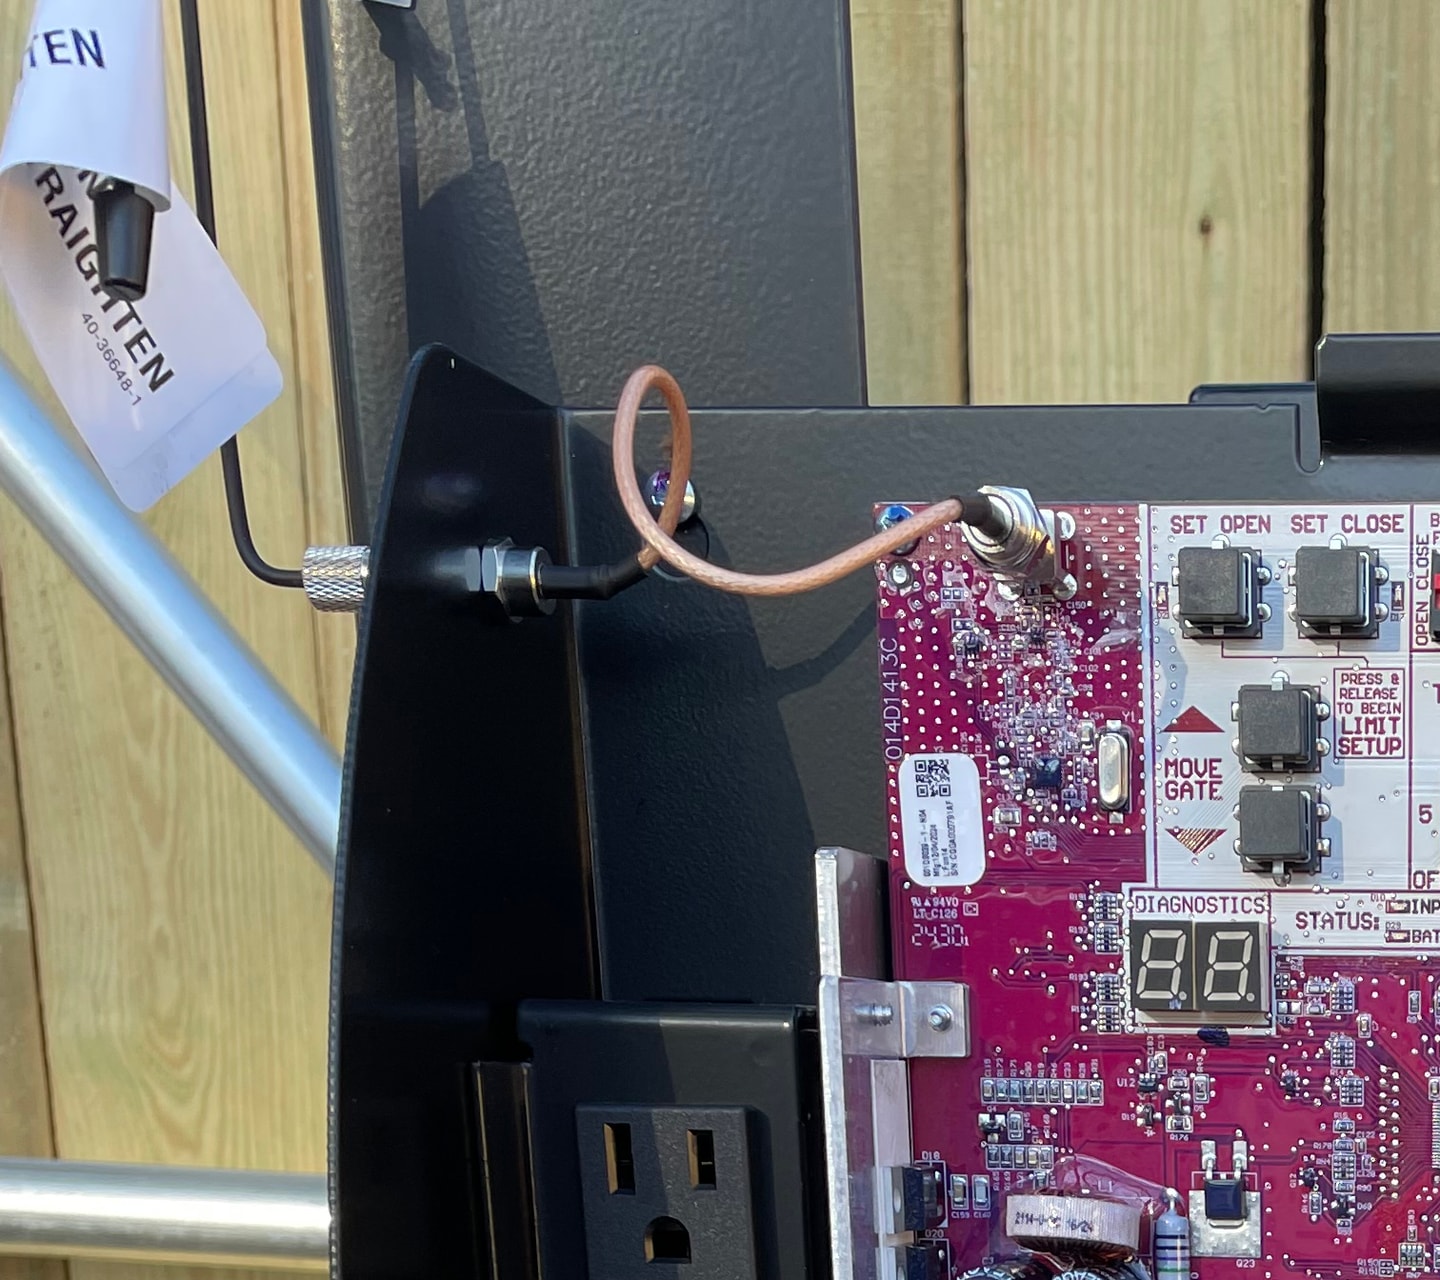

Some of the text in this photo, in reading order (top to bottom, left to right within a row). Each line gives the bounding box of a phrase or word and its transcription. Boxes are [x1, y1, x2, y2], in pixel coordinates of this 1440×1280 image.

[81, 311, 143, 406] 40-36648-1
[1170, 515, 1271, 534] SET OPEN
[1290, 514, 1405, 533] SET CLOSE
[1416, 534, 1430, 590] CLOSE
[1415, 601, 1429, 646] OPEN
[1340, 673, 1383, 685] PRESS
[1339, 688, 1398, 700] RELEASE
[1337, 702, 1401, 715] TO BEGIN
[1340, 717, 1400, 735] LIMIT
[1338, 738, 1402, 755] SETUP
[1164, 758, 1223, 779] MOVE
[1164, 781, 1223, 801] GATE
[1419, 805, 1432, 824] 5
[1135, 896, 1265, 914] DIAGNOSTICS
[1295, 912, 1381, 930] STATUS:
